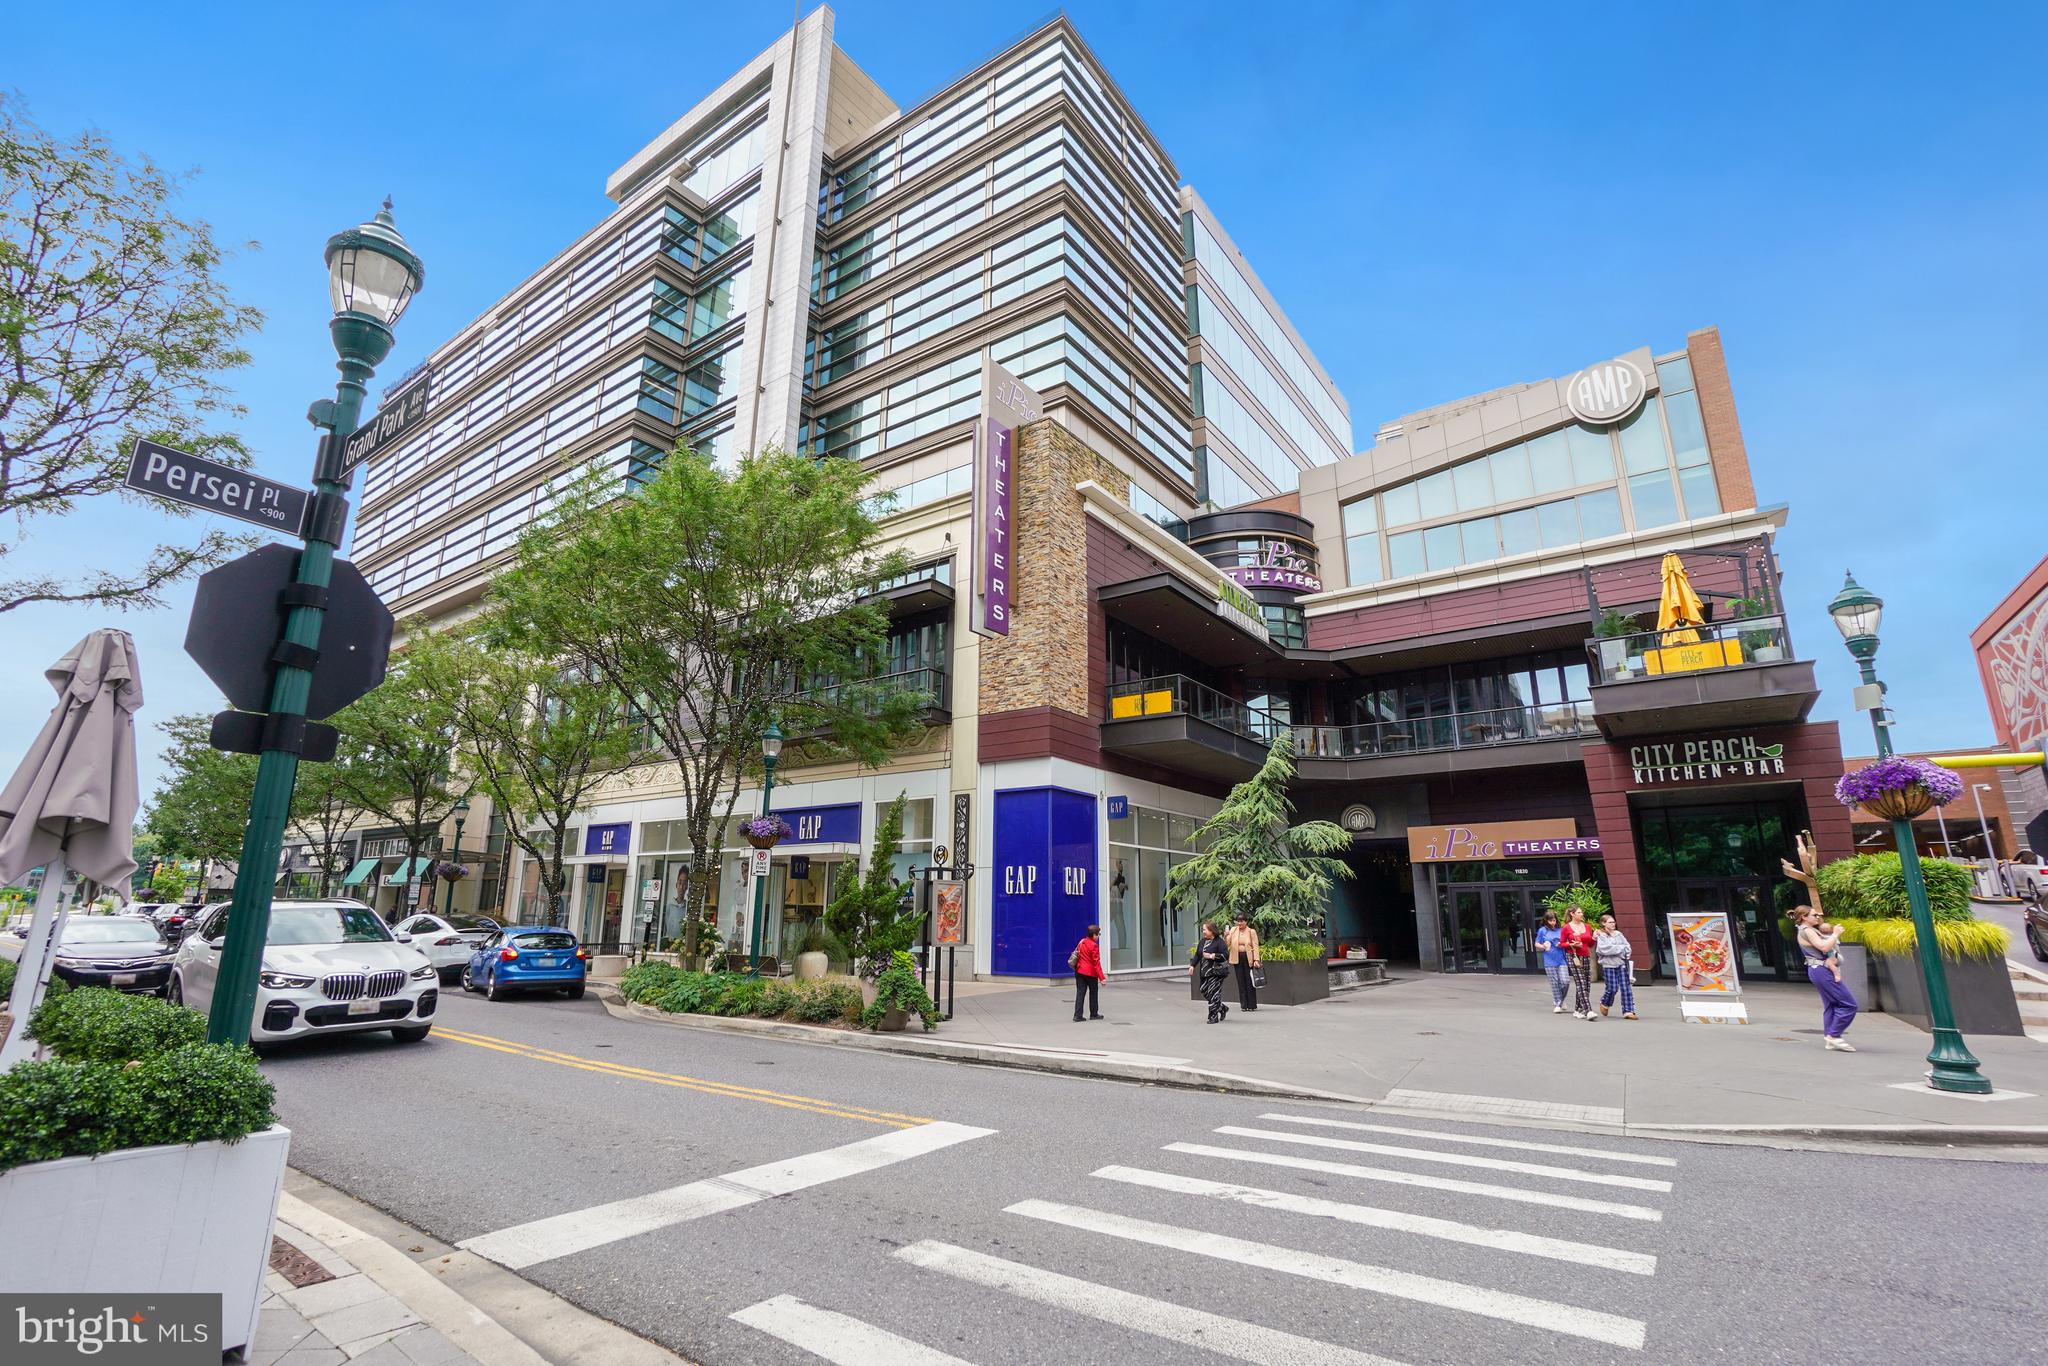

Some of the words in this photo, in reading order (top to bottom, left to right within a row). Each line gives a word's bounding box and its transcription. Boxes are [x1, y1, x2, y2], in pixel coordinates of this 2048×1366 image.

[1577, 366, 1632, 412] AMP
[345, 419, 380, 466] Grand
[379, 400, 407, 442] Park
[410, 388, 425, 409] Ave
[144, 452, 256, 511] Persei
[262, 486, 280, 507] Pl
[259, 507, 286, 522] <900
[992, 431, 1006, 621] THEATERS
[1247, 540, 1309, 573] iPic
[1229, 571, 1321, 591] THEATERS
[1681, 655, 1704, 665] PERCH
[1631, 743, 1675, 767] CITY
[1684, 736, 1757, 763] PERCH
[1634, 763, 1722, 784] KITCHEN
[1744, 759, 1785, 776] BAR
[1110, 802, 1123, 813] GAP
[1351, 814, 1366, 828] AMP
[602, 830, 614, 845] GAP
[799, 815, 822, 840] GAP
[1425, 827, 1498, 859] iPic
[1506, 839, 1600, 853] THEATERS
[1005, 865, 1037, 895] GAP
[1065, 866, 1086, 896] GAP
